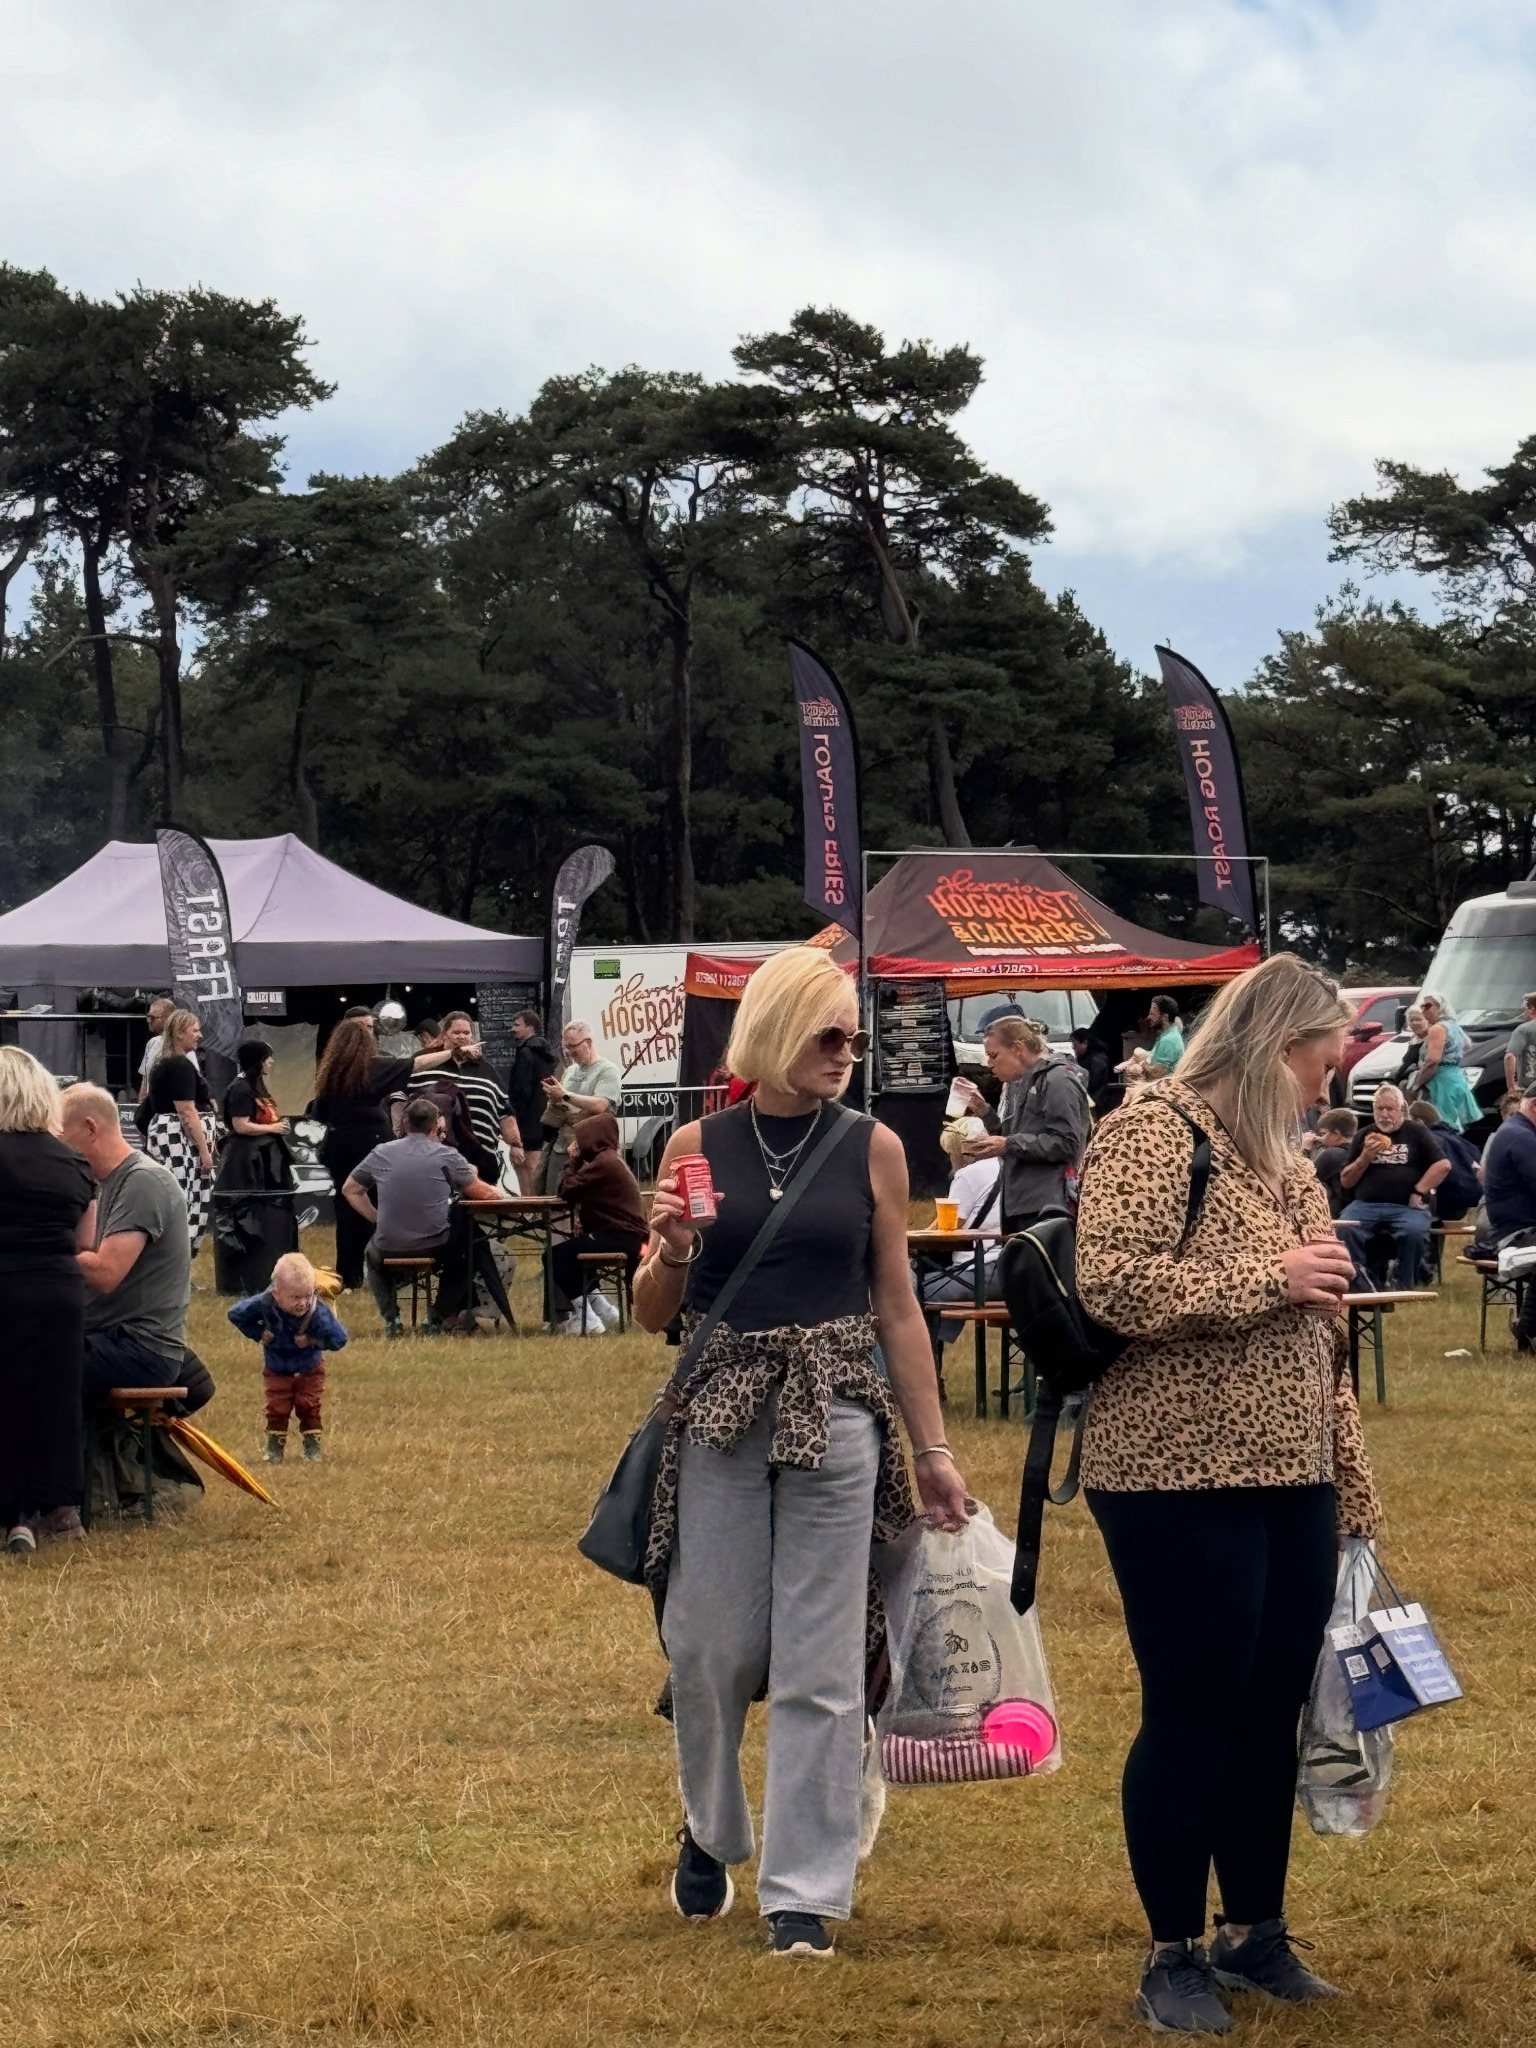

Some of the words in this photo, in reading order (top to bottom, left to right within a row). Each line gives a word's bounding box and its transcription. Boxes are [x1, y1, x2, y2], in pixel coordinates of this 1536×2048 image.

[925, 887, 1078, 921] HOGROAST
[967, 920, 1096, 944] CATERERS
[619, 1092, 644, 1107] OK
